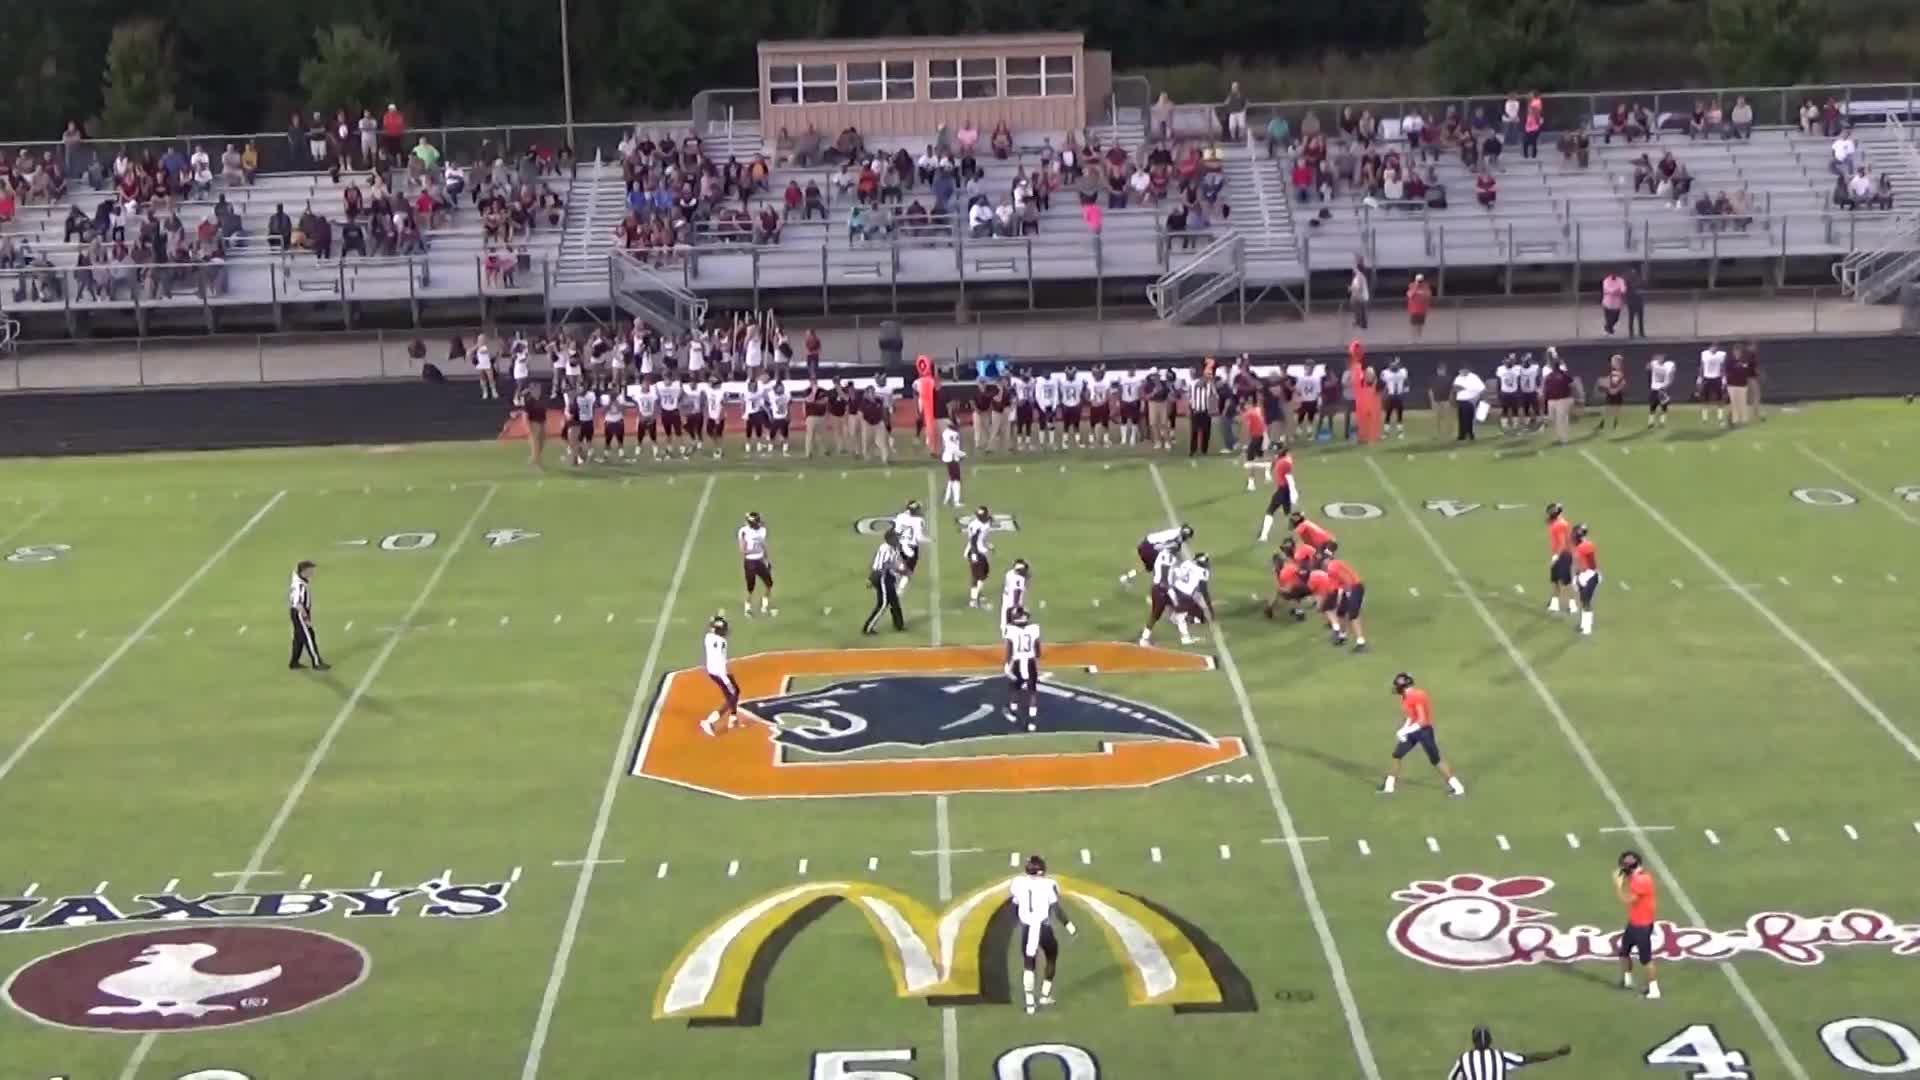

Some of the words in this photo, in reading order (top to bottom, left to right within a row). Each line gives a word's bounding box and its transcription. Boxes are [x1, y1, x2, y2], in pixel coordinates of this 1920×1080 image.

[1016, 633, 1032, 653] 13
[1028, 889, 1034, 913] 1
[1386, 886, 1920, 969] Chick-fil-
